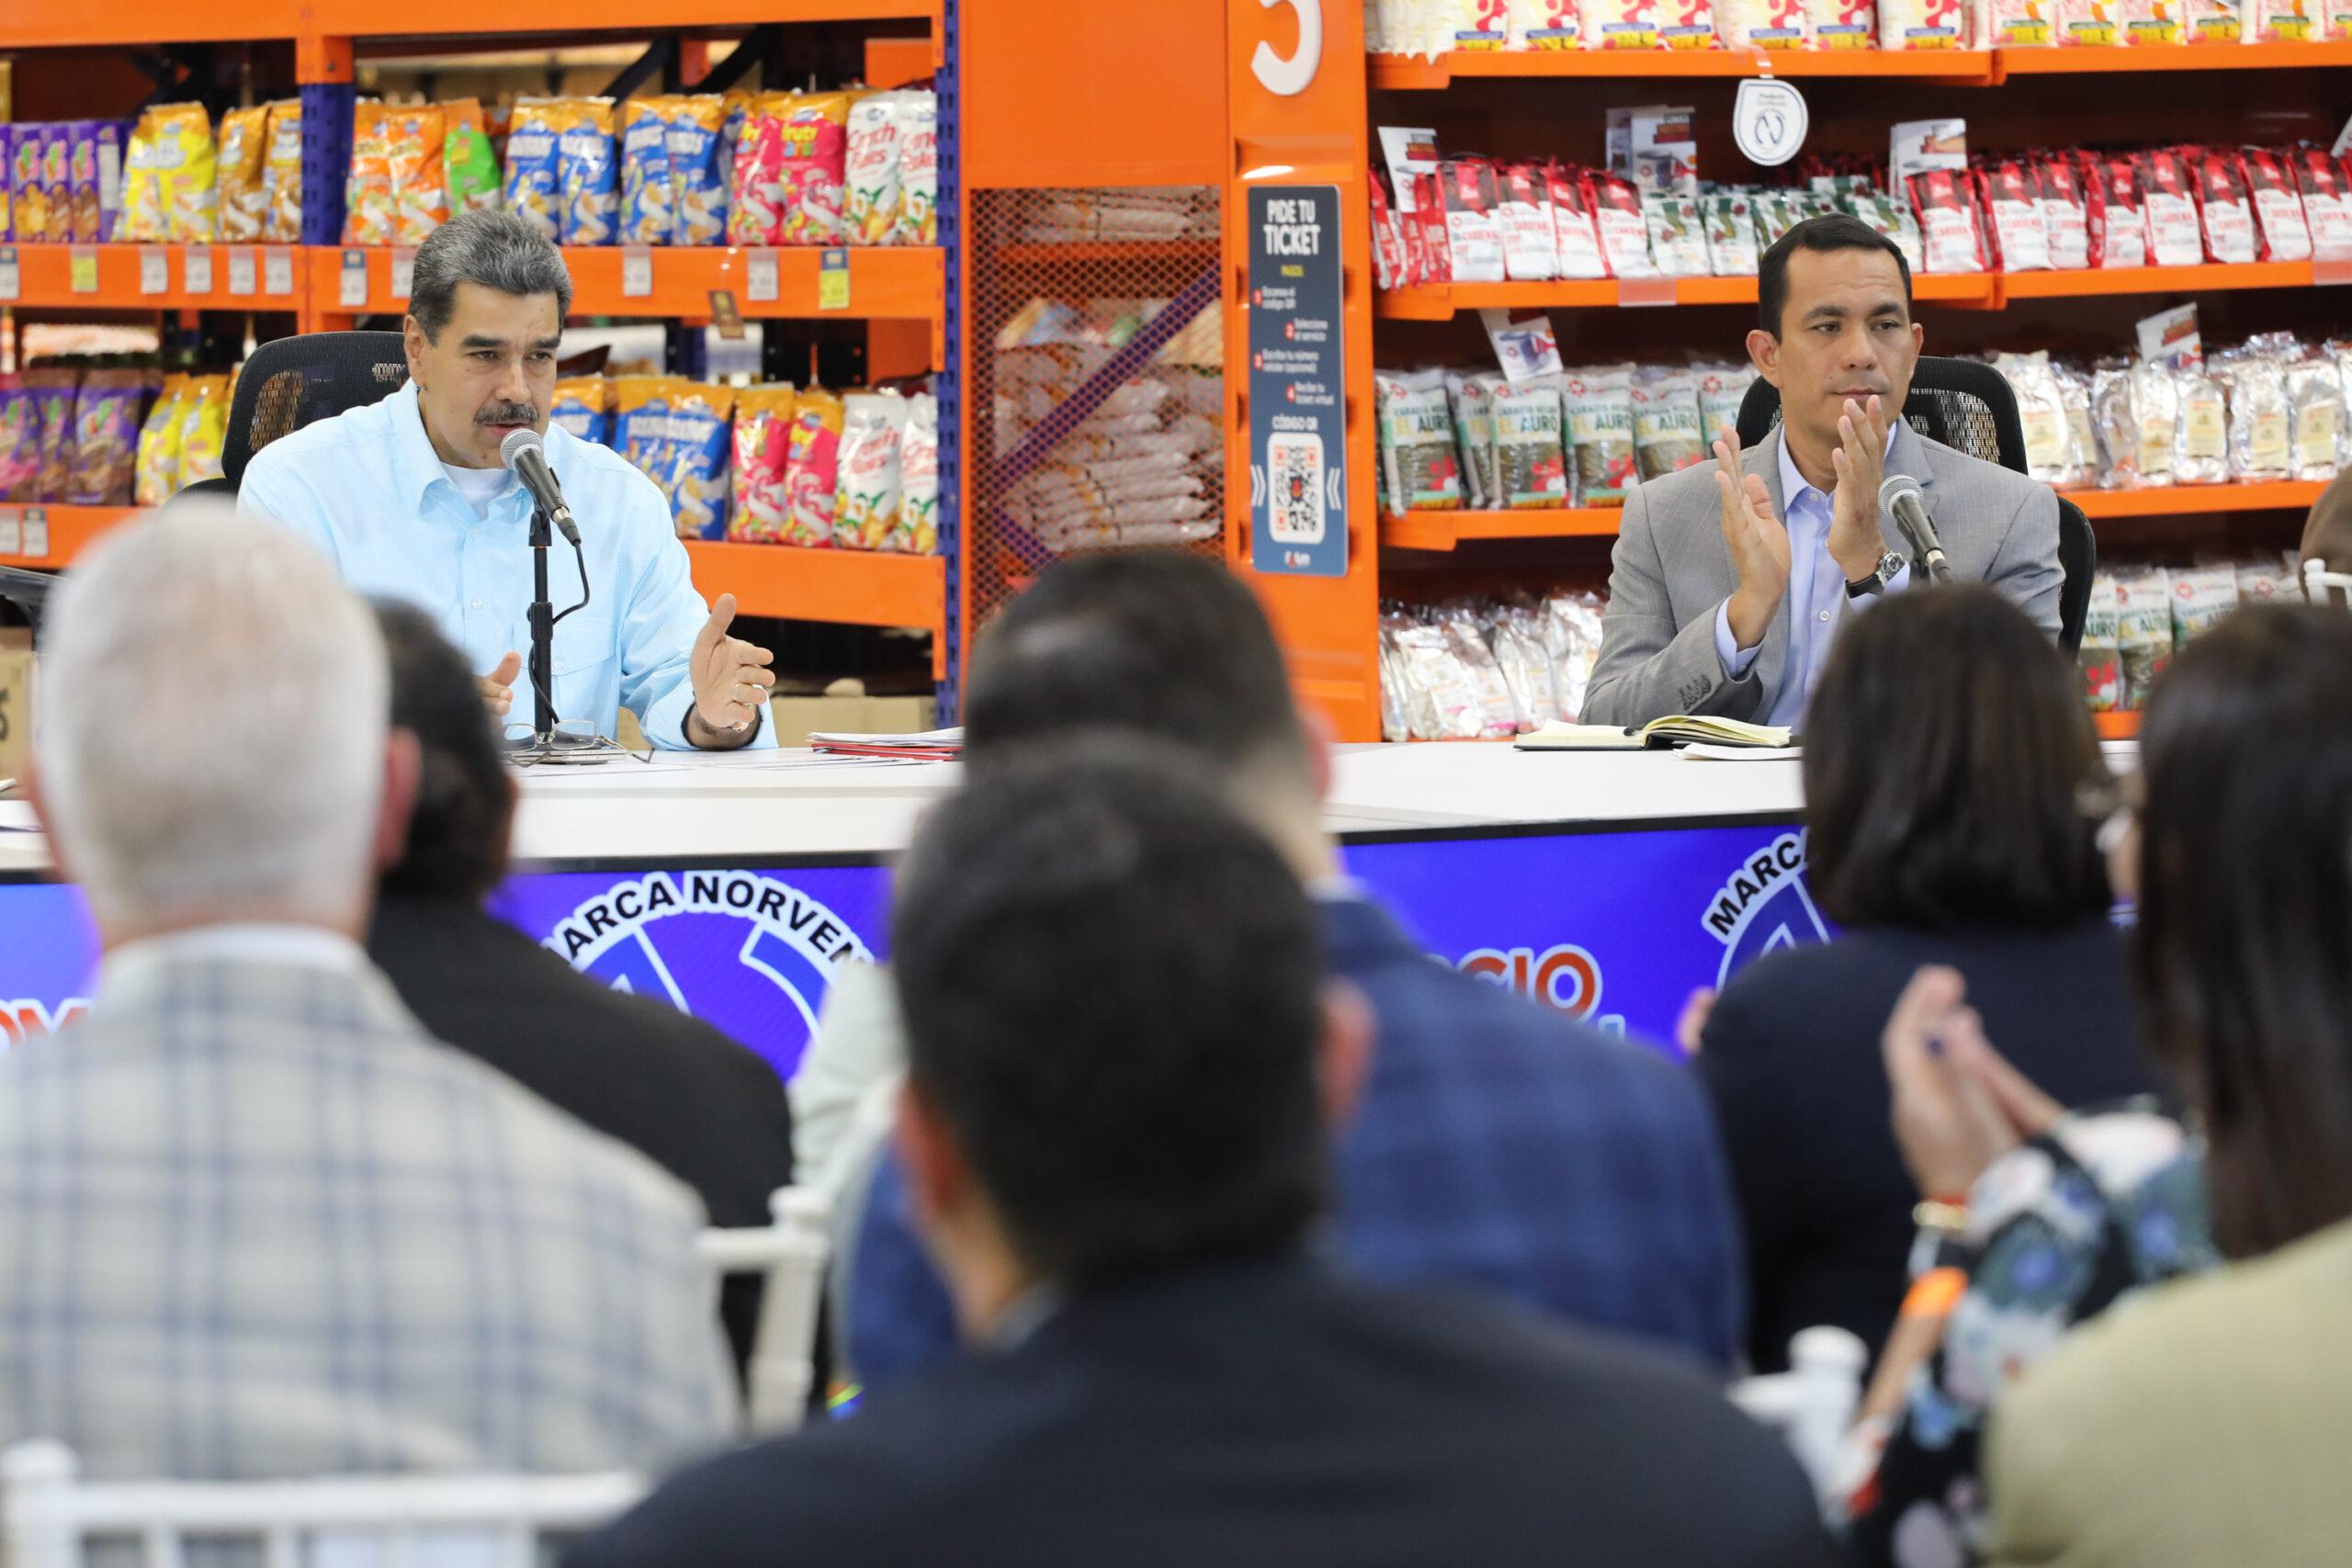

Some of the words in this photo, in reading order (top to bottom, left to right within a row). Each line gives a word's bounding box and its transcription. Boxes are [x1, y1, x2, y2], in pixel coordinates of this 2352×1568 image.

[1267, 198, 1296, 223] PIDE
[1298, 199, 1316, 223] TU
[1263, 224, 1321, 255] TICKET
[1709, 840, 1802, 936] MARC
[562, 880, 675, 959] ARCA
